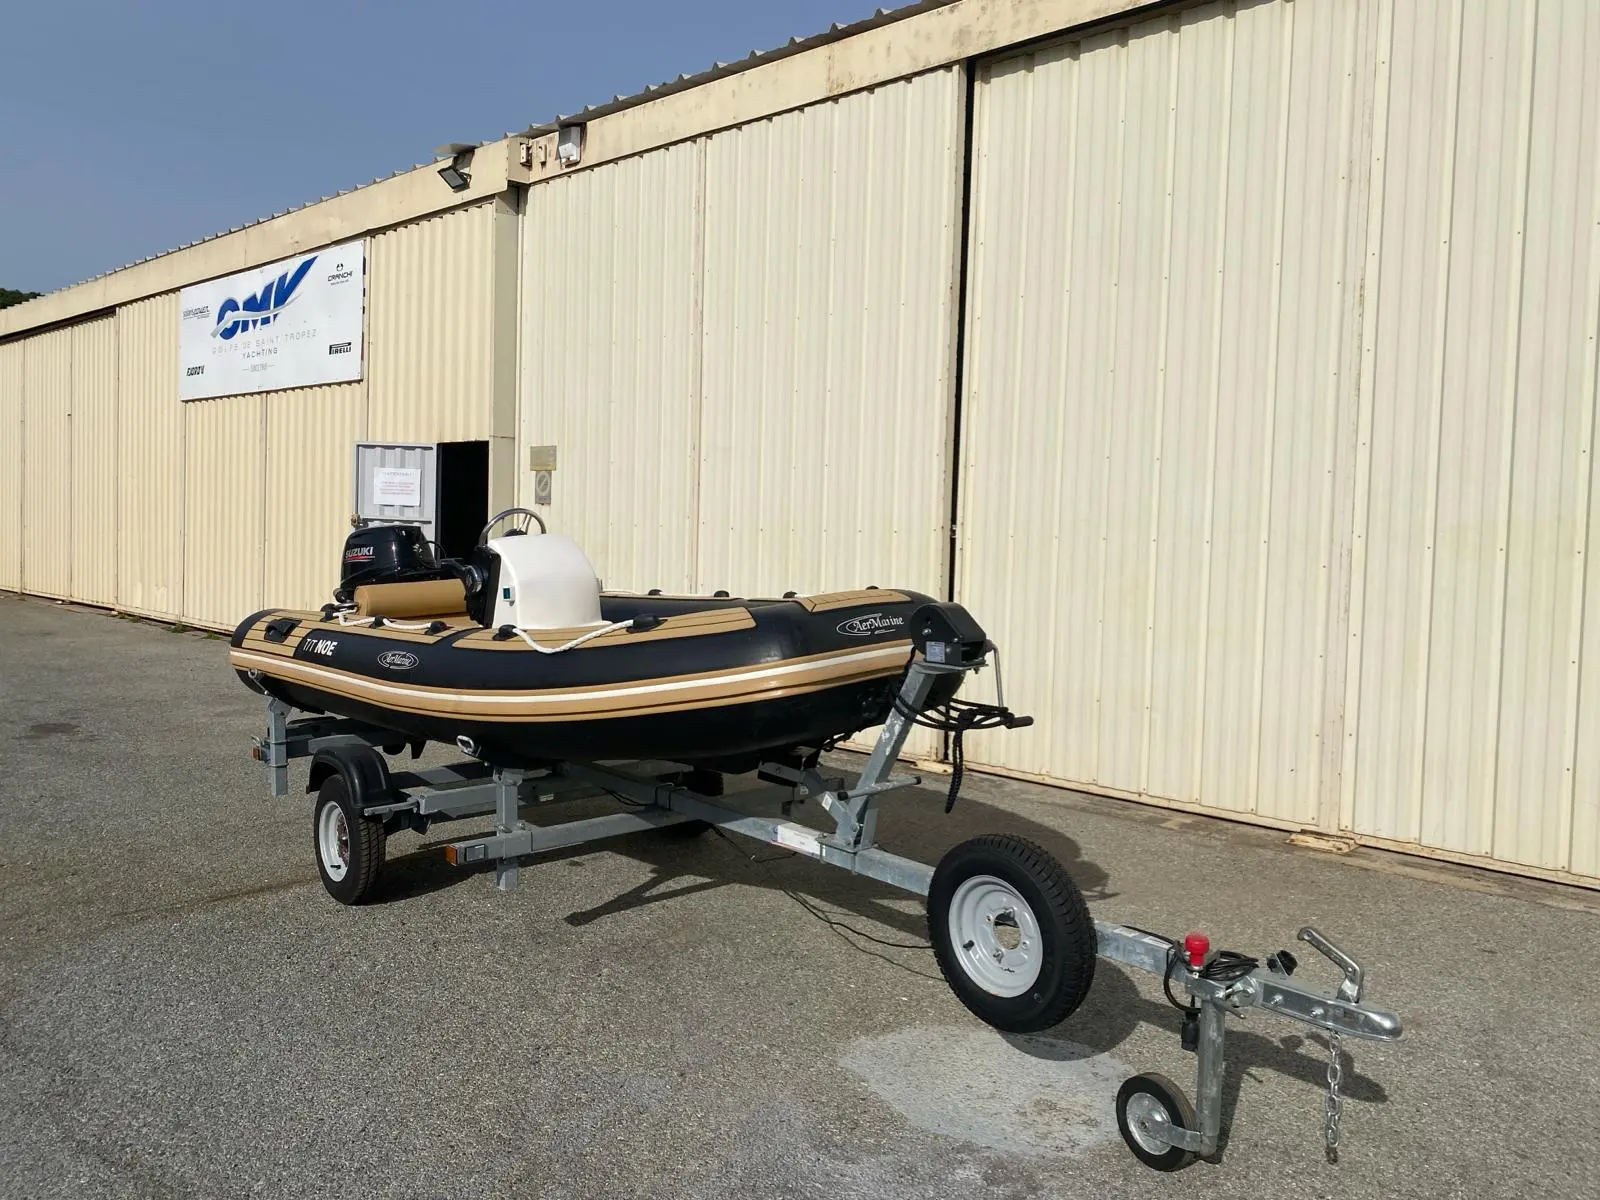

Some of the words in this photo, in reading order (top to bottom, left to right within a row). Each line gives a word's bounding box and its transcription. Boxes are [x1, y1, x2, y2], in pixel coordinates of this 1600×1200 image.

[256, 336, 279, 347] SAINT
[284, 329, 317, 342] TROPEZ
[243, 347, 278, 359] YACHTING
[329, 342, 351, 355] PIRELLI
[345, 546, 374, 558] SUZUKI
[853, 615, 905, 632] AerMarine
[314, 639, 338, 657] NOE
